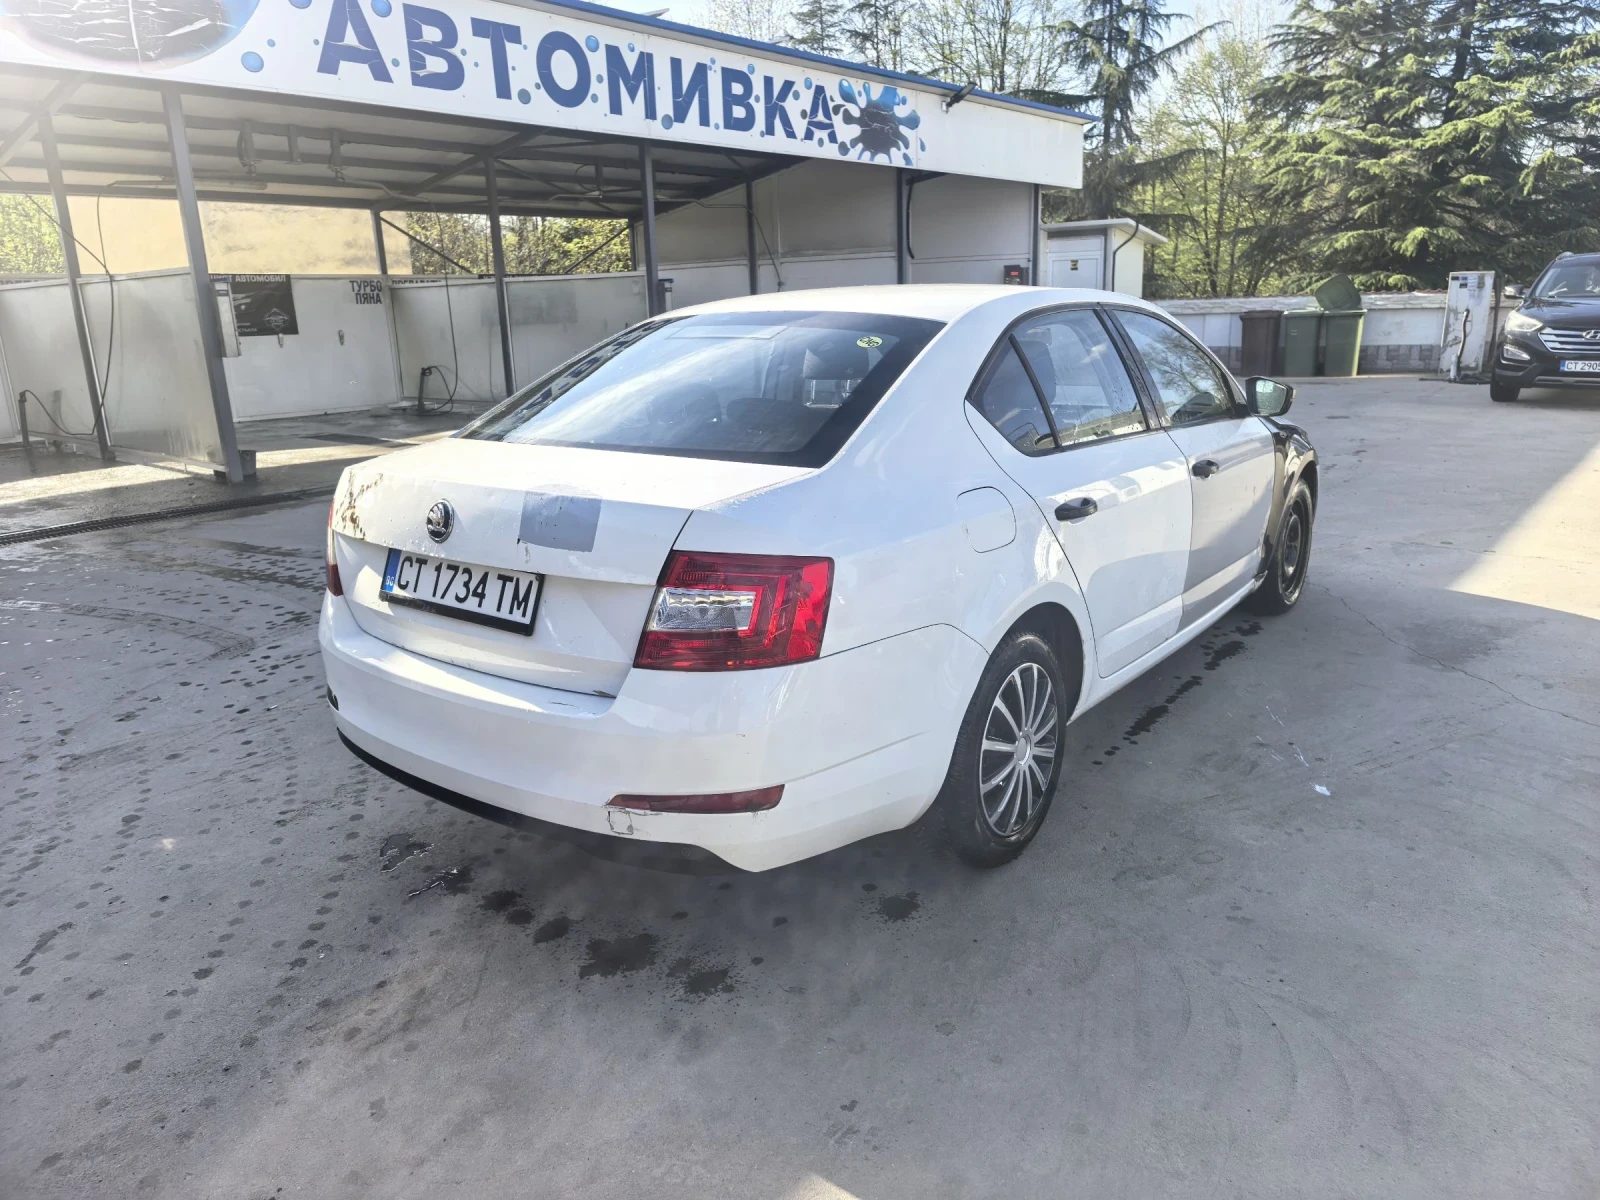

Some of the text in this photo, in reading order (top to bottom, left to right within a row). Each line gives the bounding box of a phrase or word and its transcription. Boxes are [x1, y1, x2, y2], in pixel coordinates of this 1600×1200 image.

[317, 0, 838, 144] АВТОМИВКА
[235, 274, 287, 283] АВТОМОБИЛ
[349, 280, 382, 292] ТУРБО
[355, 293, 382, 304] ПЯНА
[386, 556, 534, 618] BG CT 1734 TM
